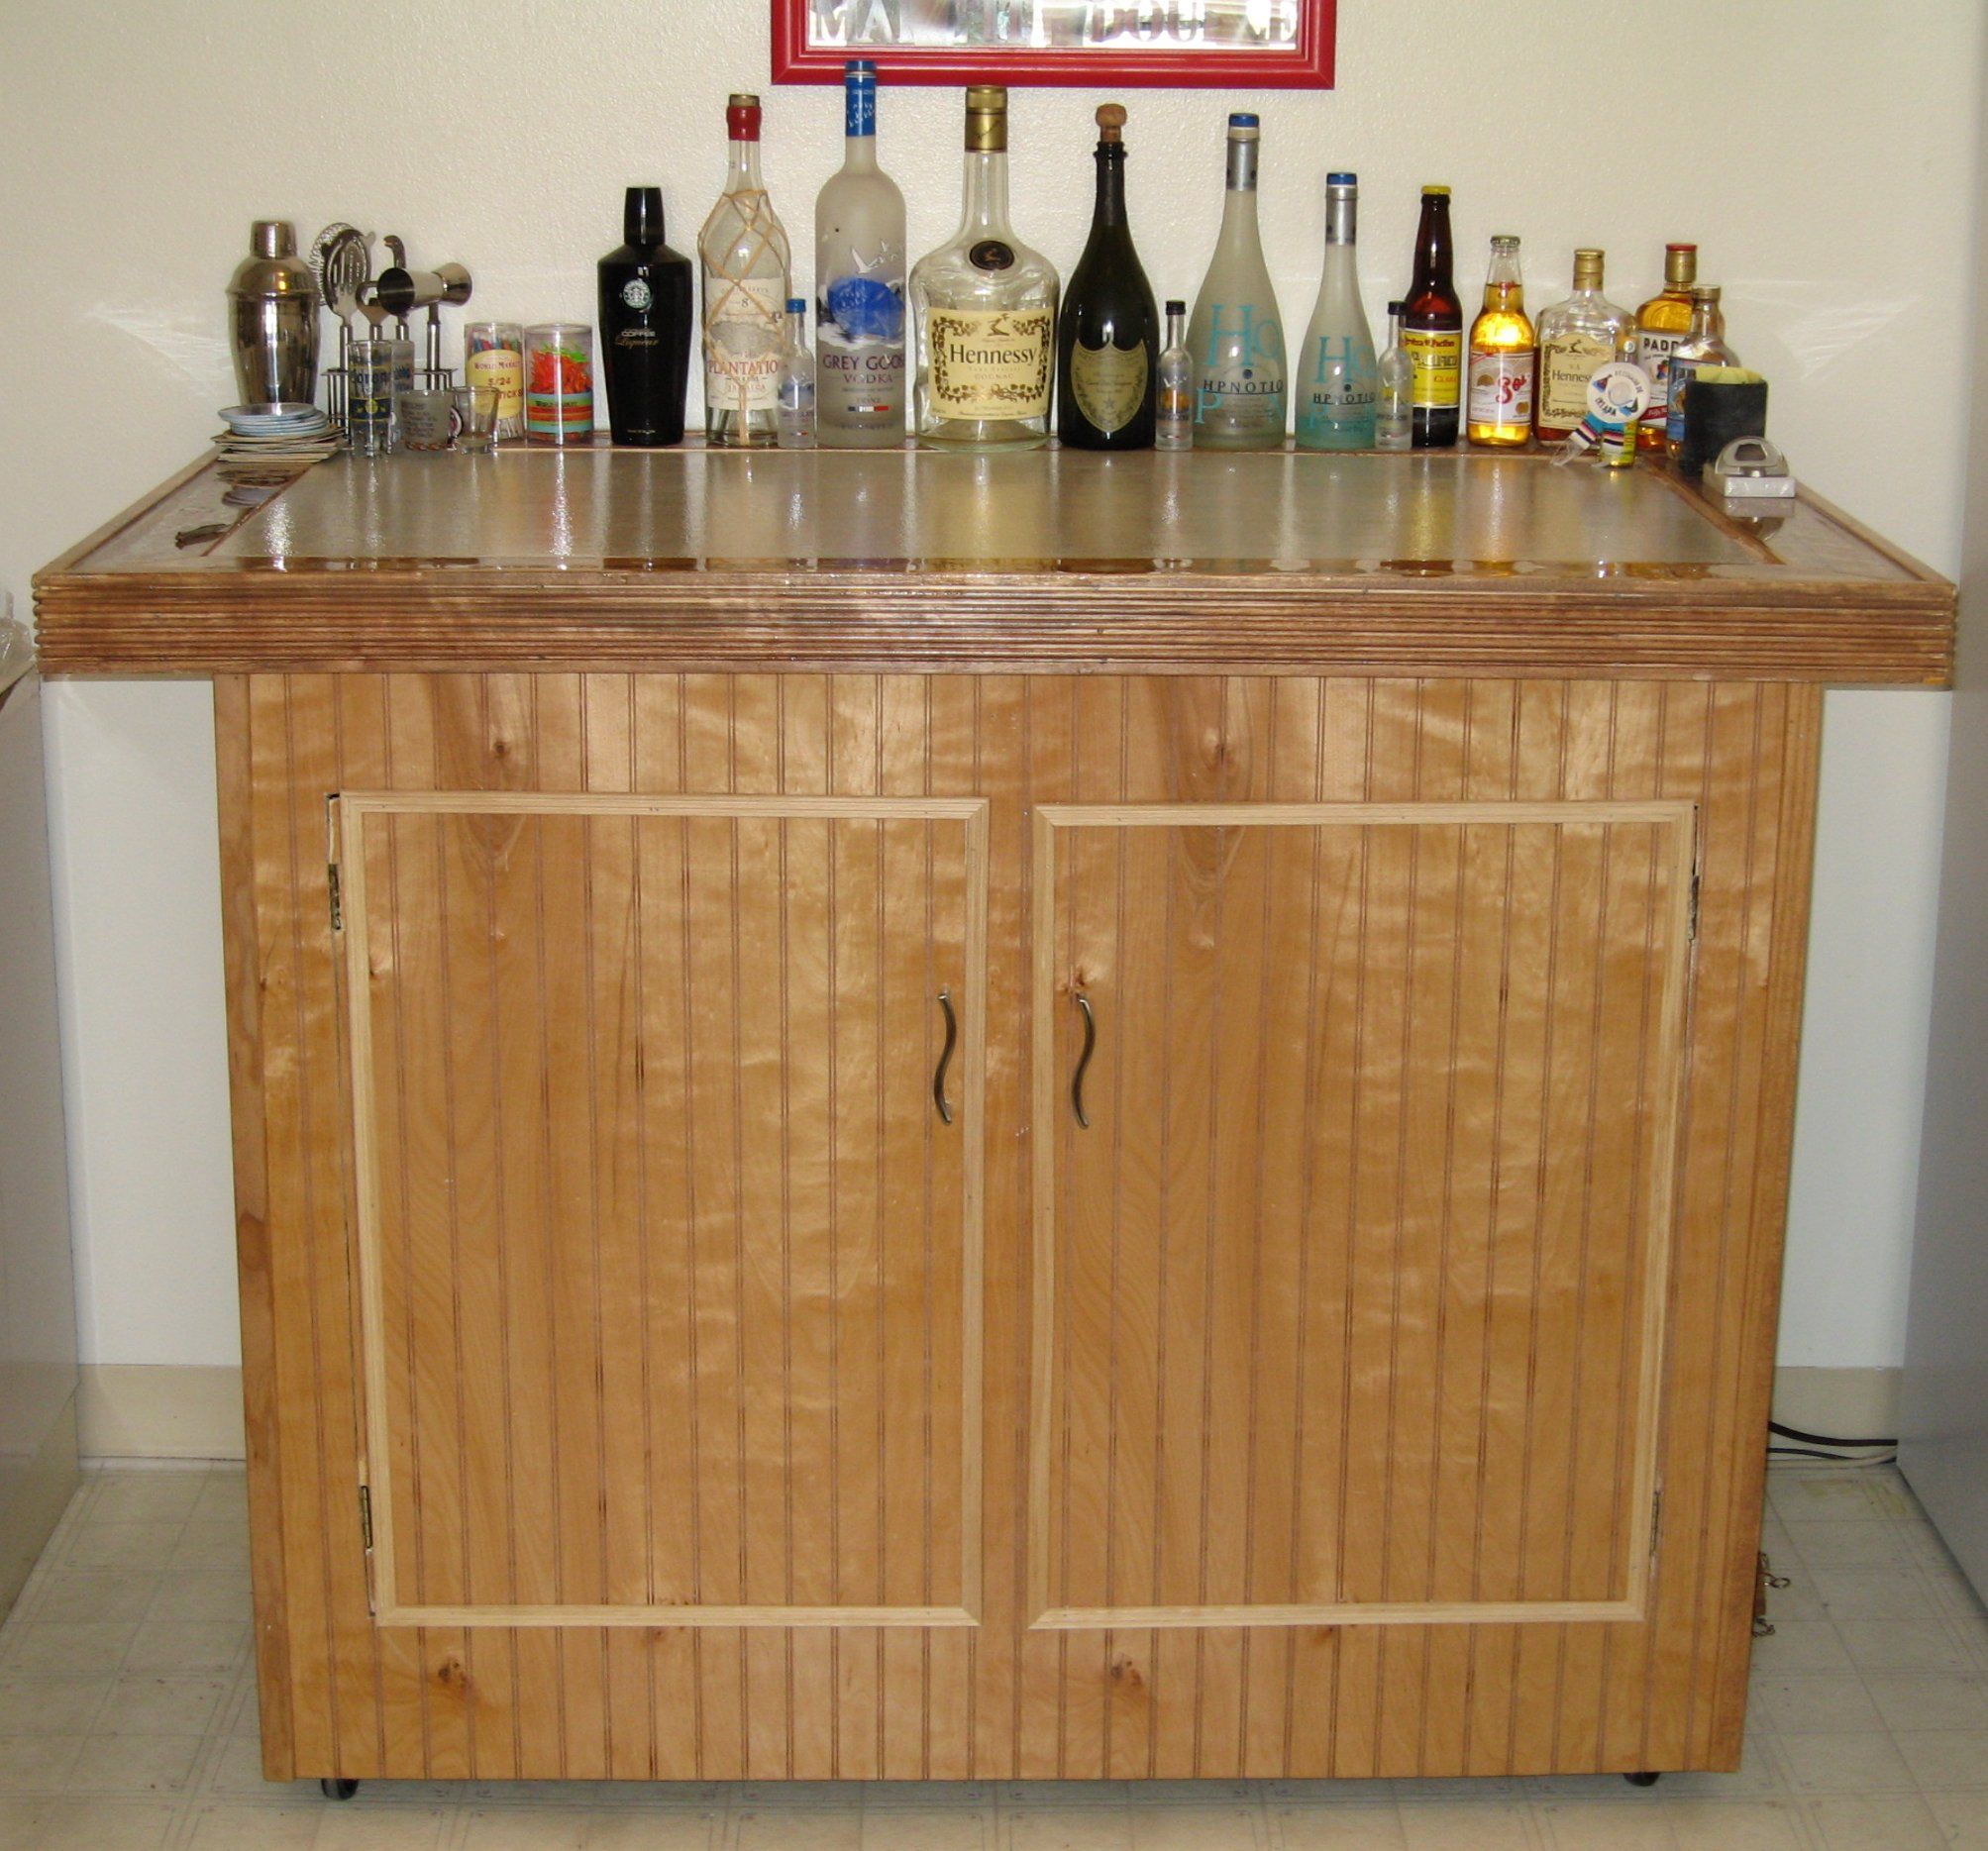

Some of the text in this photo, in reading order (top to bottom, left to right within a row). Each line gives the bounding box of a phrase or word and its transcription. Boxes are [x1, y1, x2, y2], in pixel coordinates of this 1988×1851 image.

[822, 355, 860, 370] GREY
[949, 344, 1037, 366] Hennessy
[1312, 392, 1376, 404] HPOTIQ
